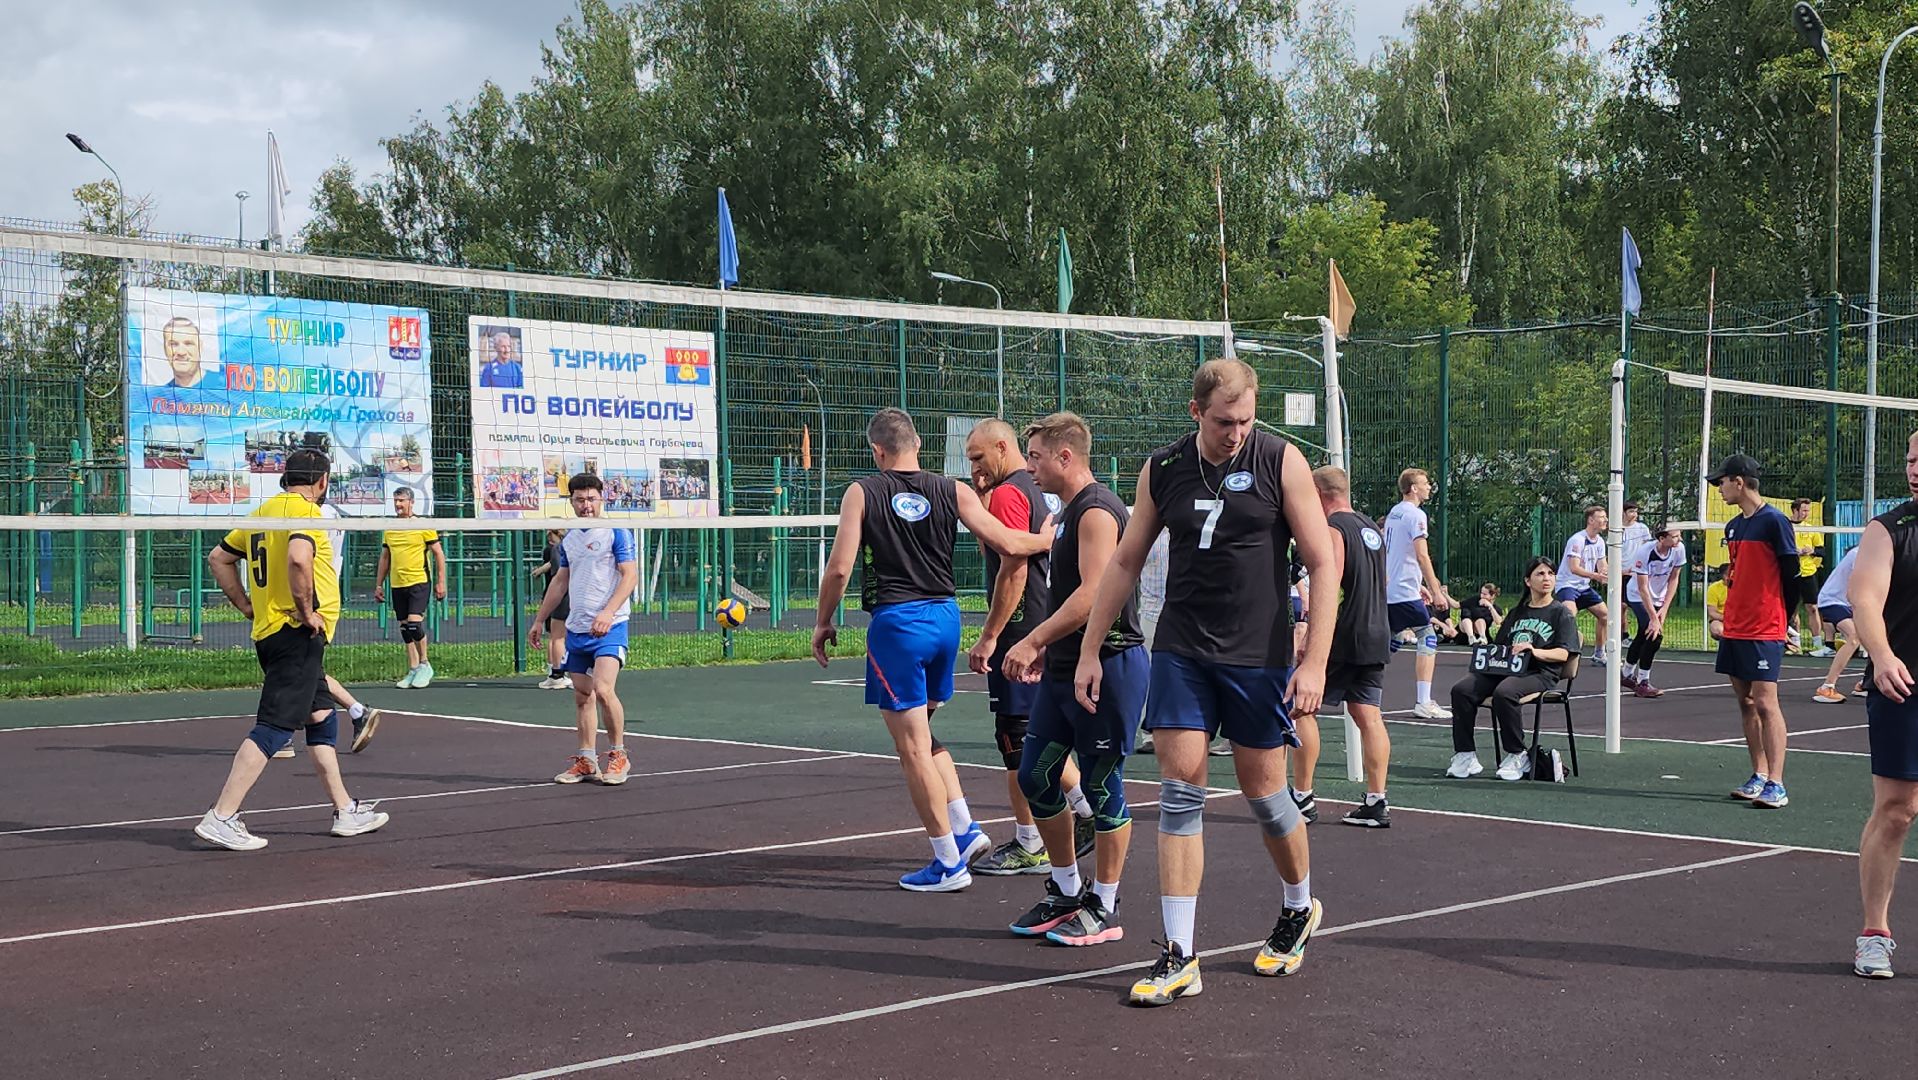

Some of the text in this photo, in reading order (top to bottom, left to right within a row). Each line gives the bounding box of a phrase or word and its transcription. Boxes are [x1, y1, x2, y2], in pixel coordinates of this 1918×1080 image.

[266, 317, 345, 347] ТУРНИР
[549, 348, 647, 372] ТУРНИР
[226, 363, 386, 397] ПО ВОЛЕЙБОЛУ
[152, 397, 231, 418] Памяти
[238, 401, 341, 424] Александра
[501, 393, 693, 421] ПО ВОЛЕЙБОЛУ
[489, 433, 534, 443] памяти
[539, 434, 571, 446] Юрия
[575, 435, 645, 447] Васильевича
[1194, 499, 1224, 549] 7
[250, 531, 267, 588] 5
[1475, 648, 1487, 670] 5
[1511, 653, 1525, 673] 5
